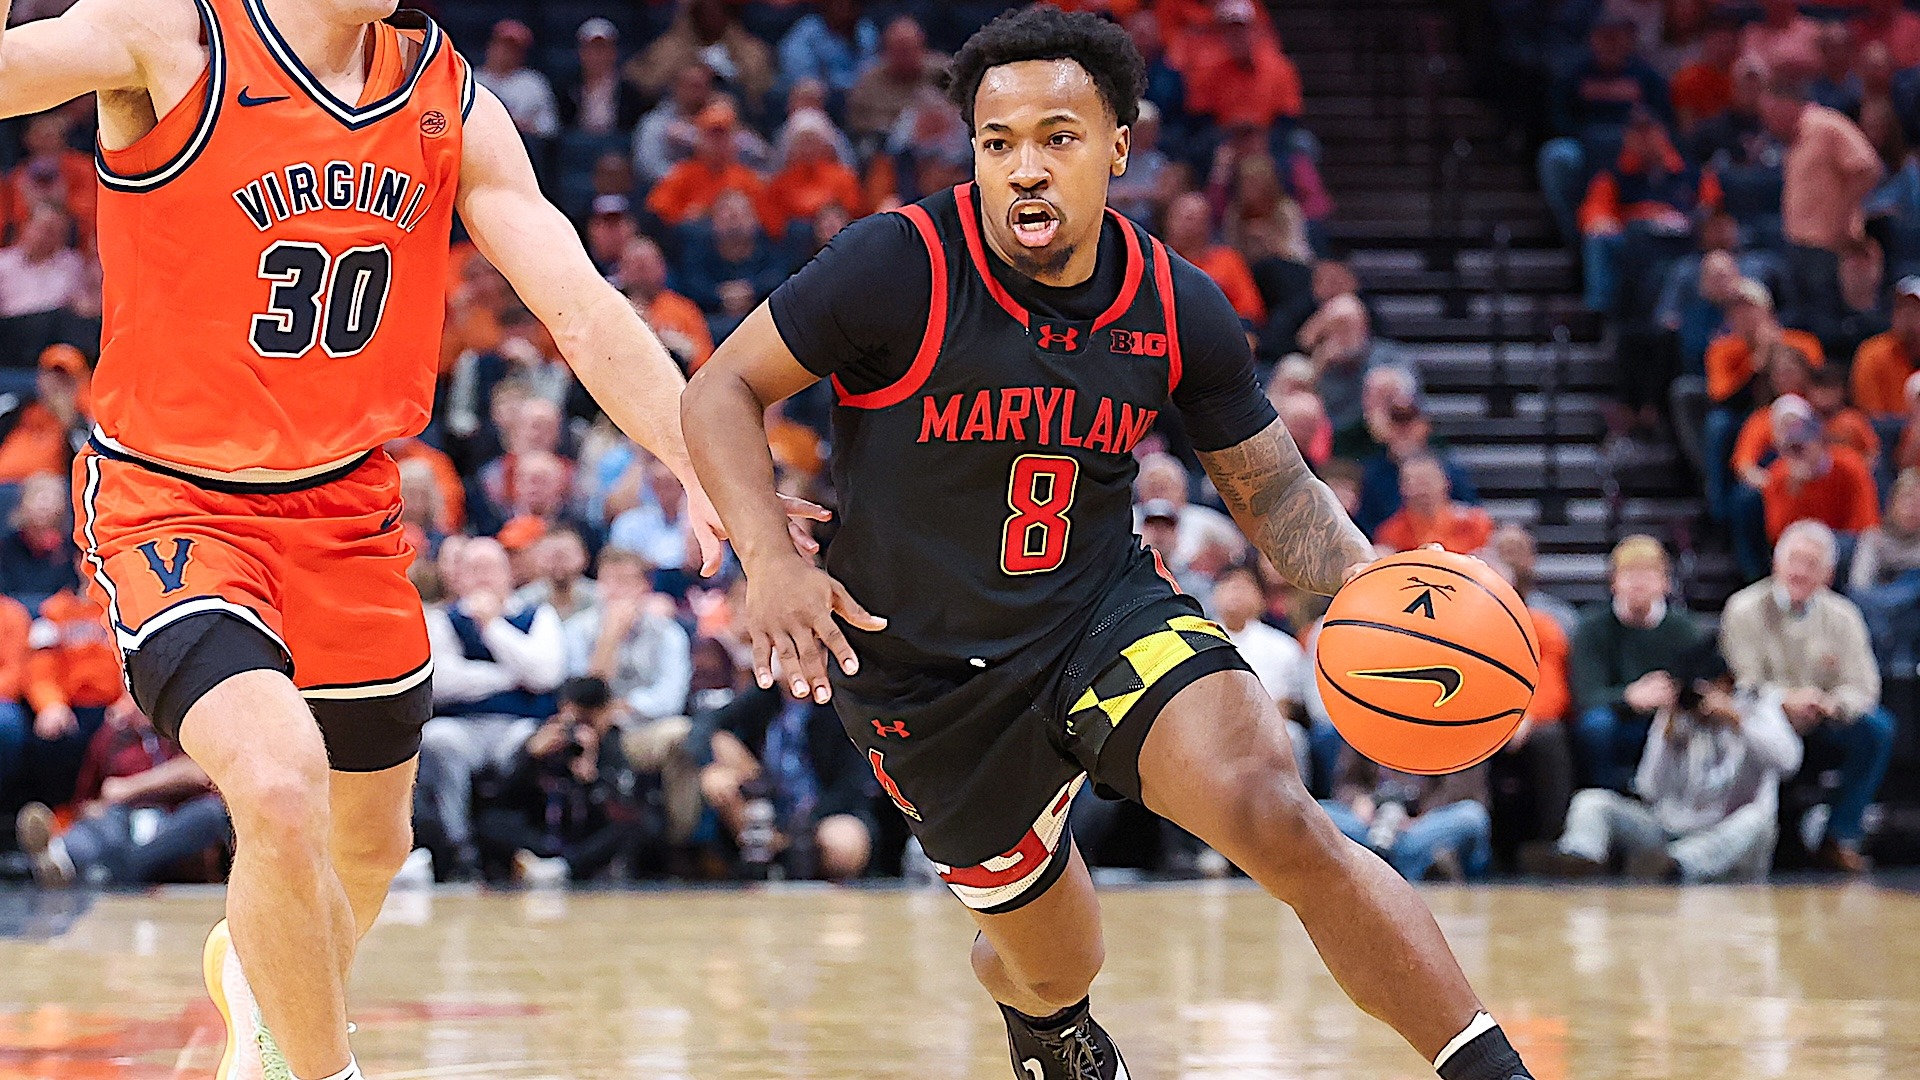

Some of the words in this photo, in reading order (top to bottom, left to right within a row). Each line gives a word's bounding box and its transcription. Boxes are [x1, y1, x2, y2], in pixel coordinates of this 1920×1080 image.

[232, 160, 431, 233] VIRGINI
[248, 239, 392, 359] 30
[1000, 453, 1080, 576] 8
[134, 536, 199, 597] V
